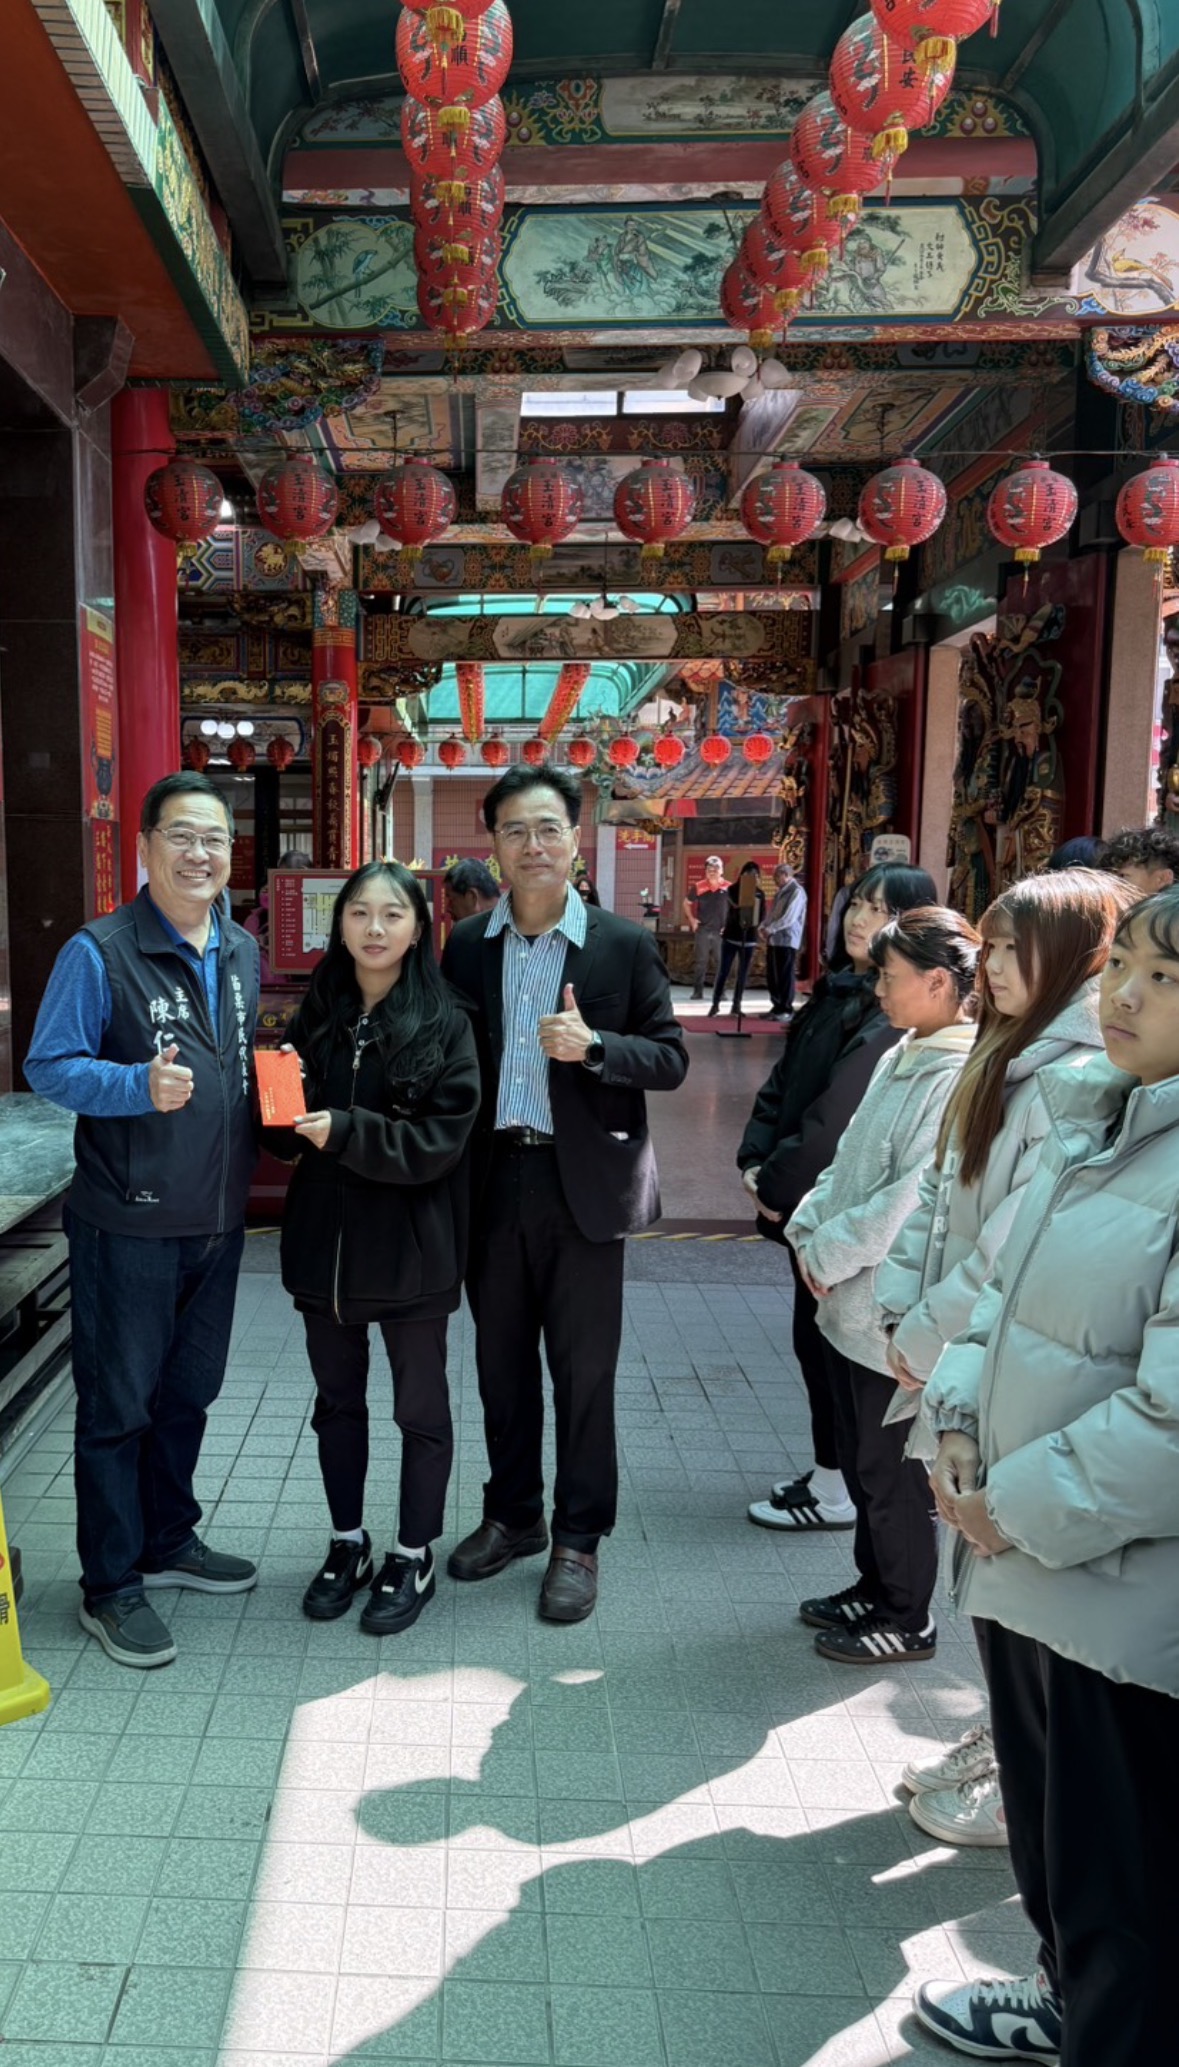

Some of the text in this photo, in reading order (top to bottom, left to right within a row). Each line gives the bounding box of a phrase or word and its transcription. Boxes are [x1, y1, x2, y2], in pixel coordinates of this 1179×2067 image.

[174, 474, 190, 521] 玉清宮
[292, 474, 307, 520] 玉清宮
[413, 478, 426, 526] 玉清宮
[541, 479, 556, 527] 玉清宮
[662, 478, 673, 526] 玉清宮
[792, 482, 806, 528] 玉清宮
[912, 480, 926, 527] 玉清宮
[1042, 483, 1056, 531] 玉清宮
[174, 986, 189, 1020] 主席
